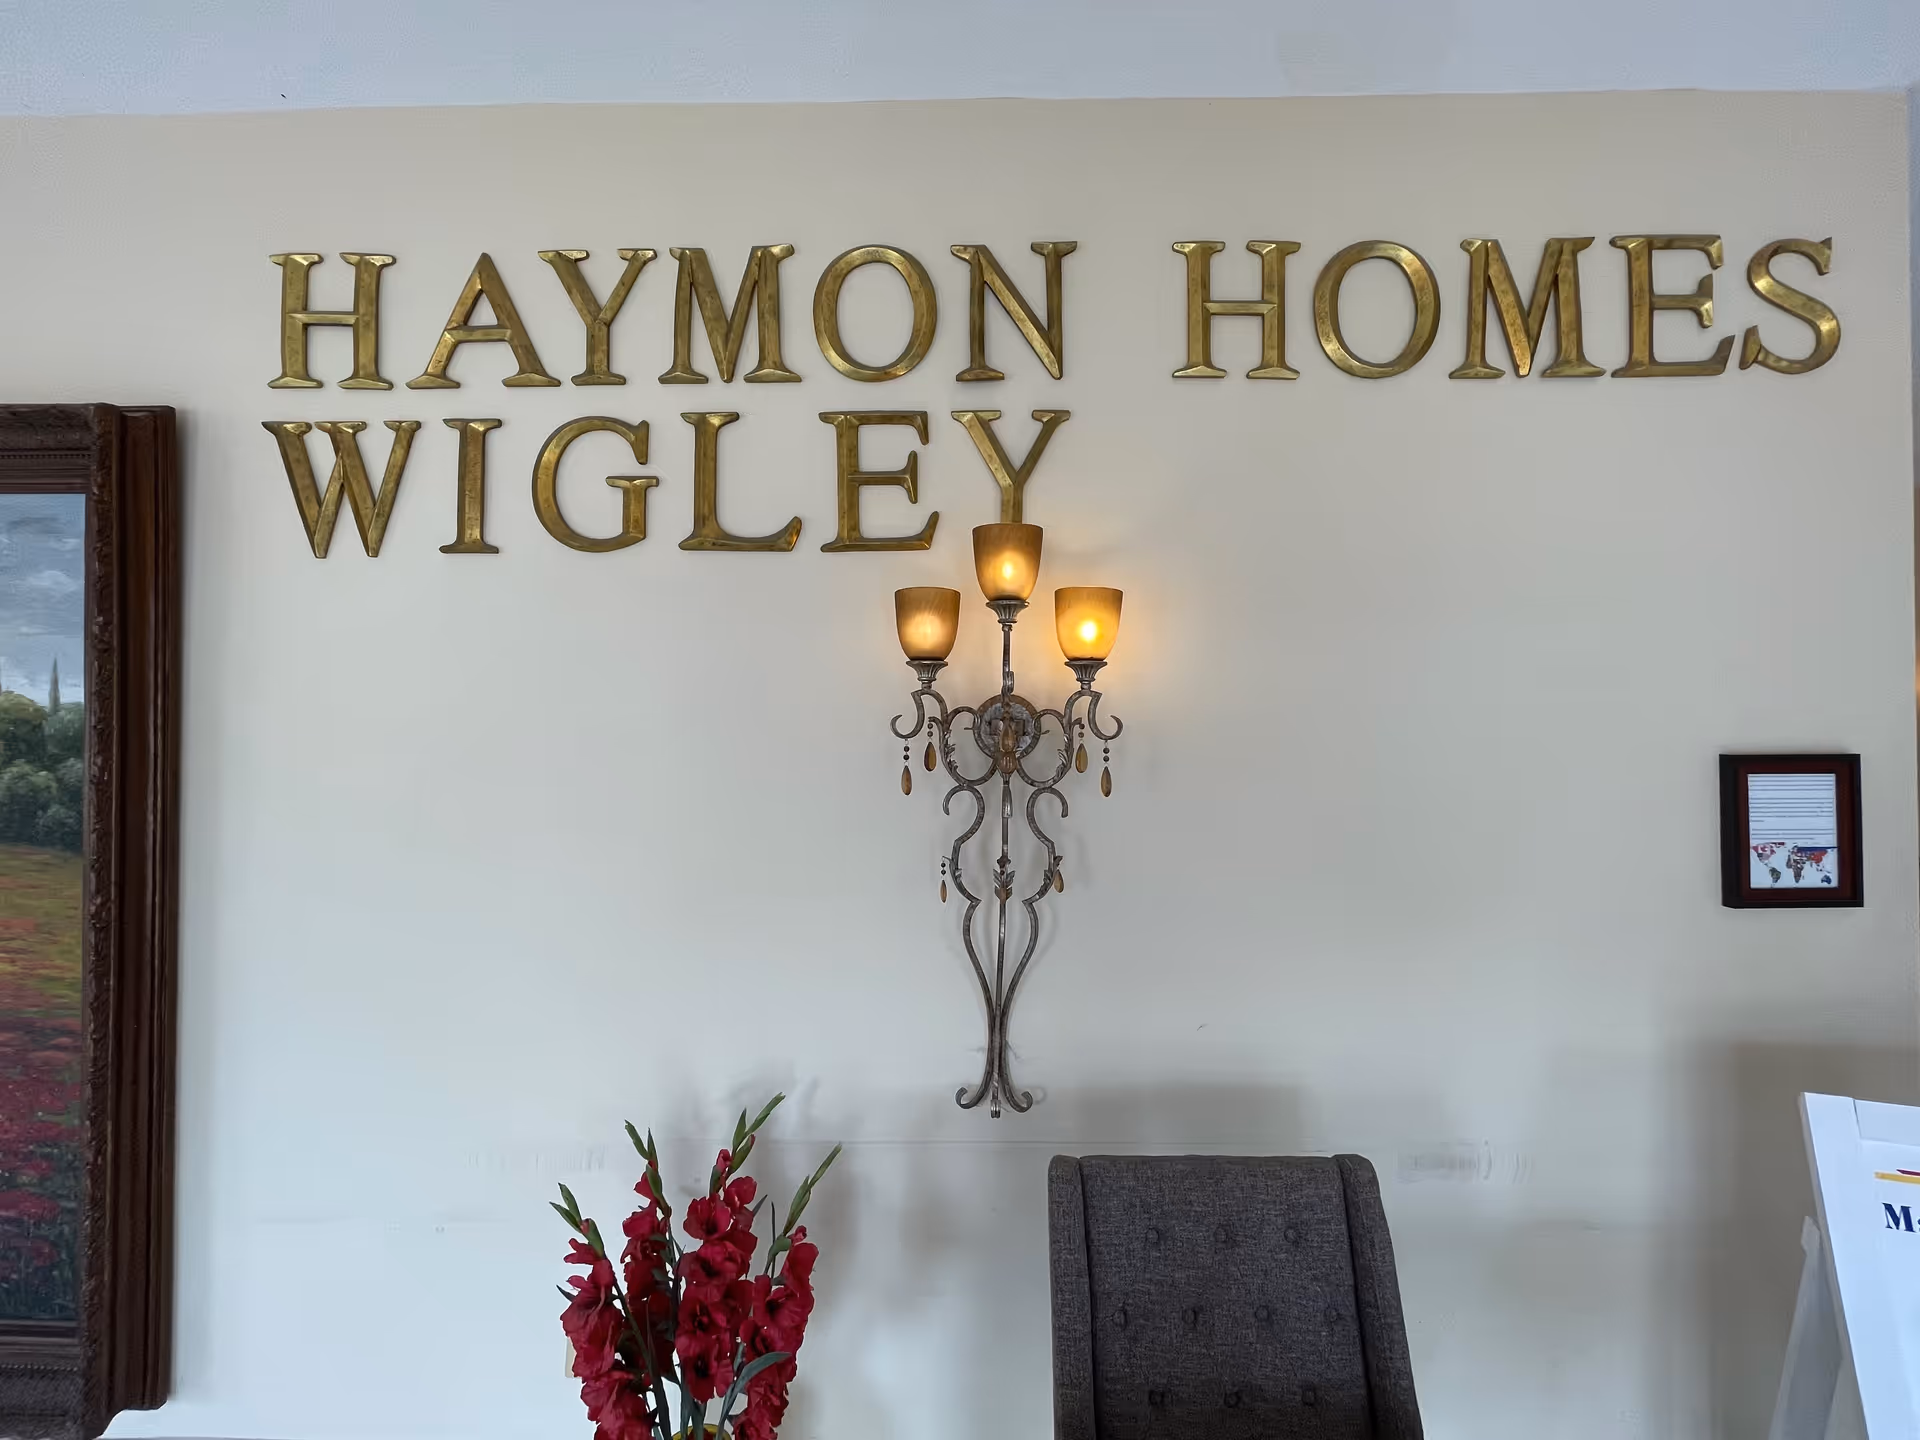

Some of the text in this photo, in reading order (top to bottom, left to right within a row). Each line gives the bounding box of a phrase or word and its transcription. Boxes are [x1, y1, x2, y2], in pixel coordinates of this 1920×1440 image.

[269, 234, 1841, 390] HAYMON HOMES
[262, 409, 1071, 559] WIGLEY
[1881, 1202, 1920, 1233] M
